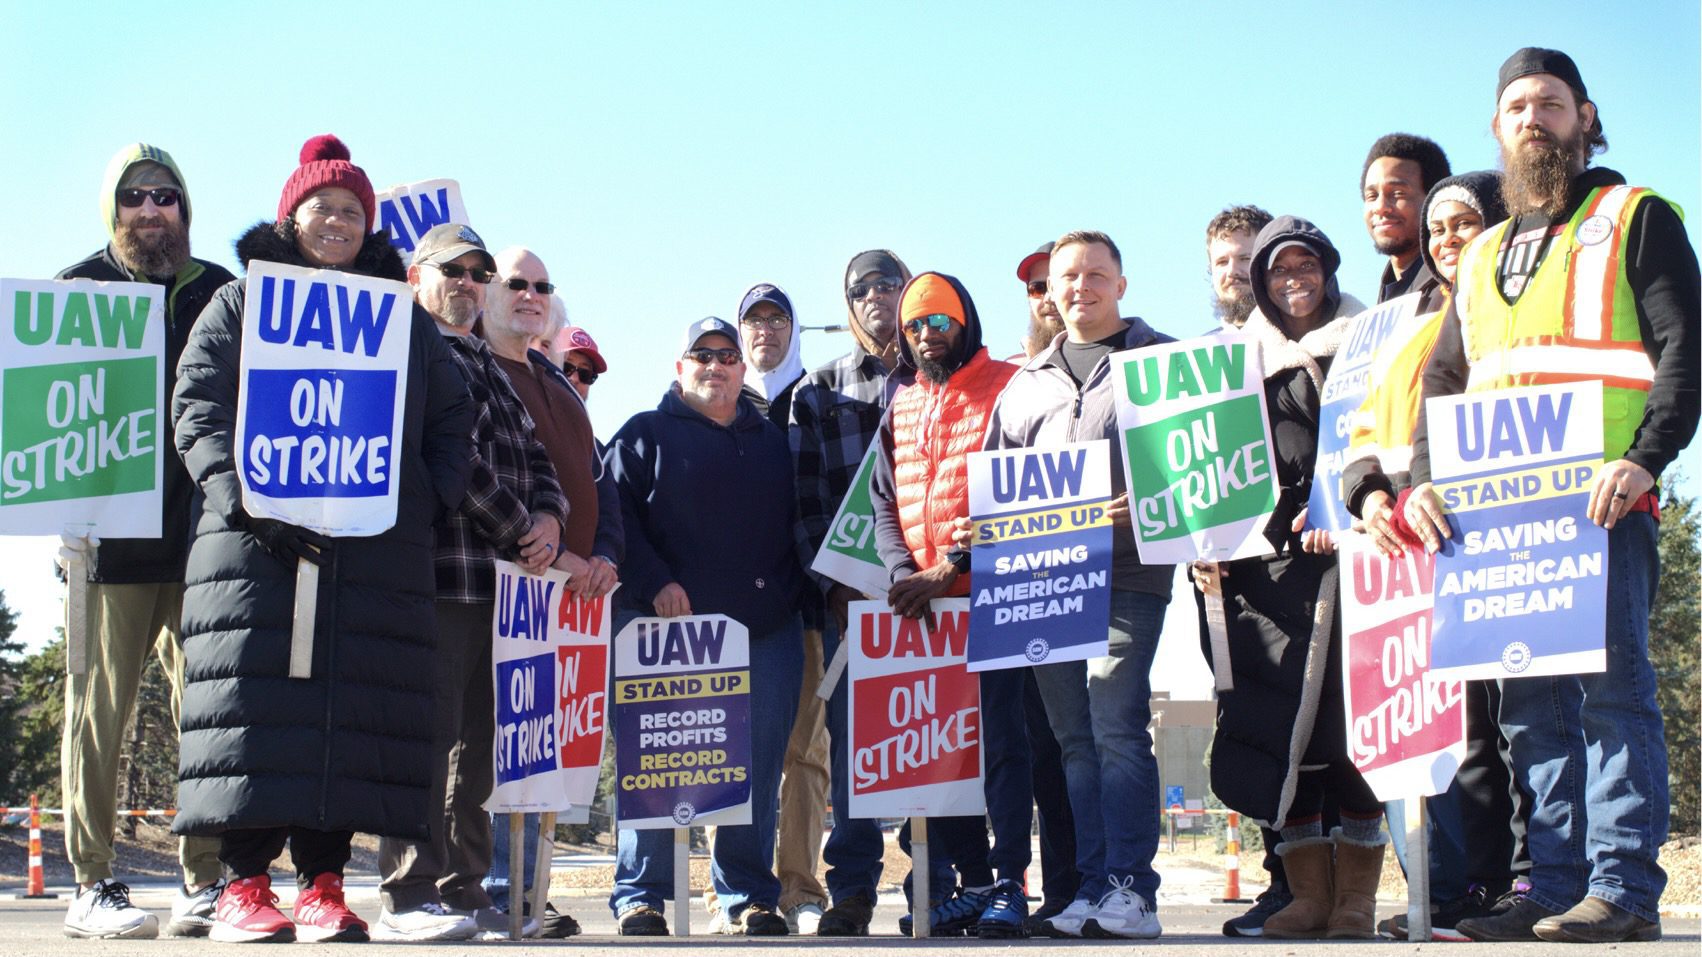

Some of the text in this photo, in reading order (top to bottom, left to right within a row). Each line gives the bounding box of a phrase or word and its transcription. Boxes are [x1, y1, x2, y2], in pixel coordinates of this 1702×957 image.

[380, 188, 450, 252] AW
[14, 290, 152, 350] UAW
[258, 275, 396, 358] UAW
[1345, 304, 1403, 360] UAW
[46, 367, 106, 428] ON
[1124, 343, 1246, 407] UAW
[290, 378, 345, 428] ON
[1455, 391, 1573, 463] UAW
[2, 408, 155, 499] STRIKE
[249, 435, 390, 487] STRIKE
[1166, 411, 1218, 473] ON
[991, 449, 1087, 504] UAW
[1138, 439, 1270, 538] STRIKE
[1443, 466, 1594, 510] STAND UP
[979, 506, 1104, 541] STAND UP
[1464, 516, 1578, 555] SAVING
[994, 545, 1089, 575] SAVING
[1032, 570, 1050, 580] THE
[1439, 552, 1602, 597] AMERICAN
[1510, 550, 1531, 560] THE
[498, 573, 556, 642] UAW
[558, 588, 605, 637] AW
[975, 570, 1107, 608] AMERICAN
[994, 595, 1083, 625] DREAM
[1463, 586, 1574, 623] DREAM
[637, 620, 727, 667] UAW
[861, 611, 970, 659] UAW
[1381, 616, 1428, 689] ON
[510, 664, 536, 714] ON
[558, 651, 581, 699] N
[623, 675, 742, 700] STAND UP
[639, 708, 727, 730] RECORD
[888, 674, 936, 728] ON
[1352, 671, 1462, 769] STRIKE
[496, 713, 554, 774] STRIKE
[639, 727, 727, 749] PROFITS
[640, 749, 727, 771] RECORD
[854, 706, 979, 790] STRIKE
[621, 766, 748, 792] CONTRACTS
